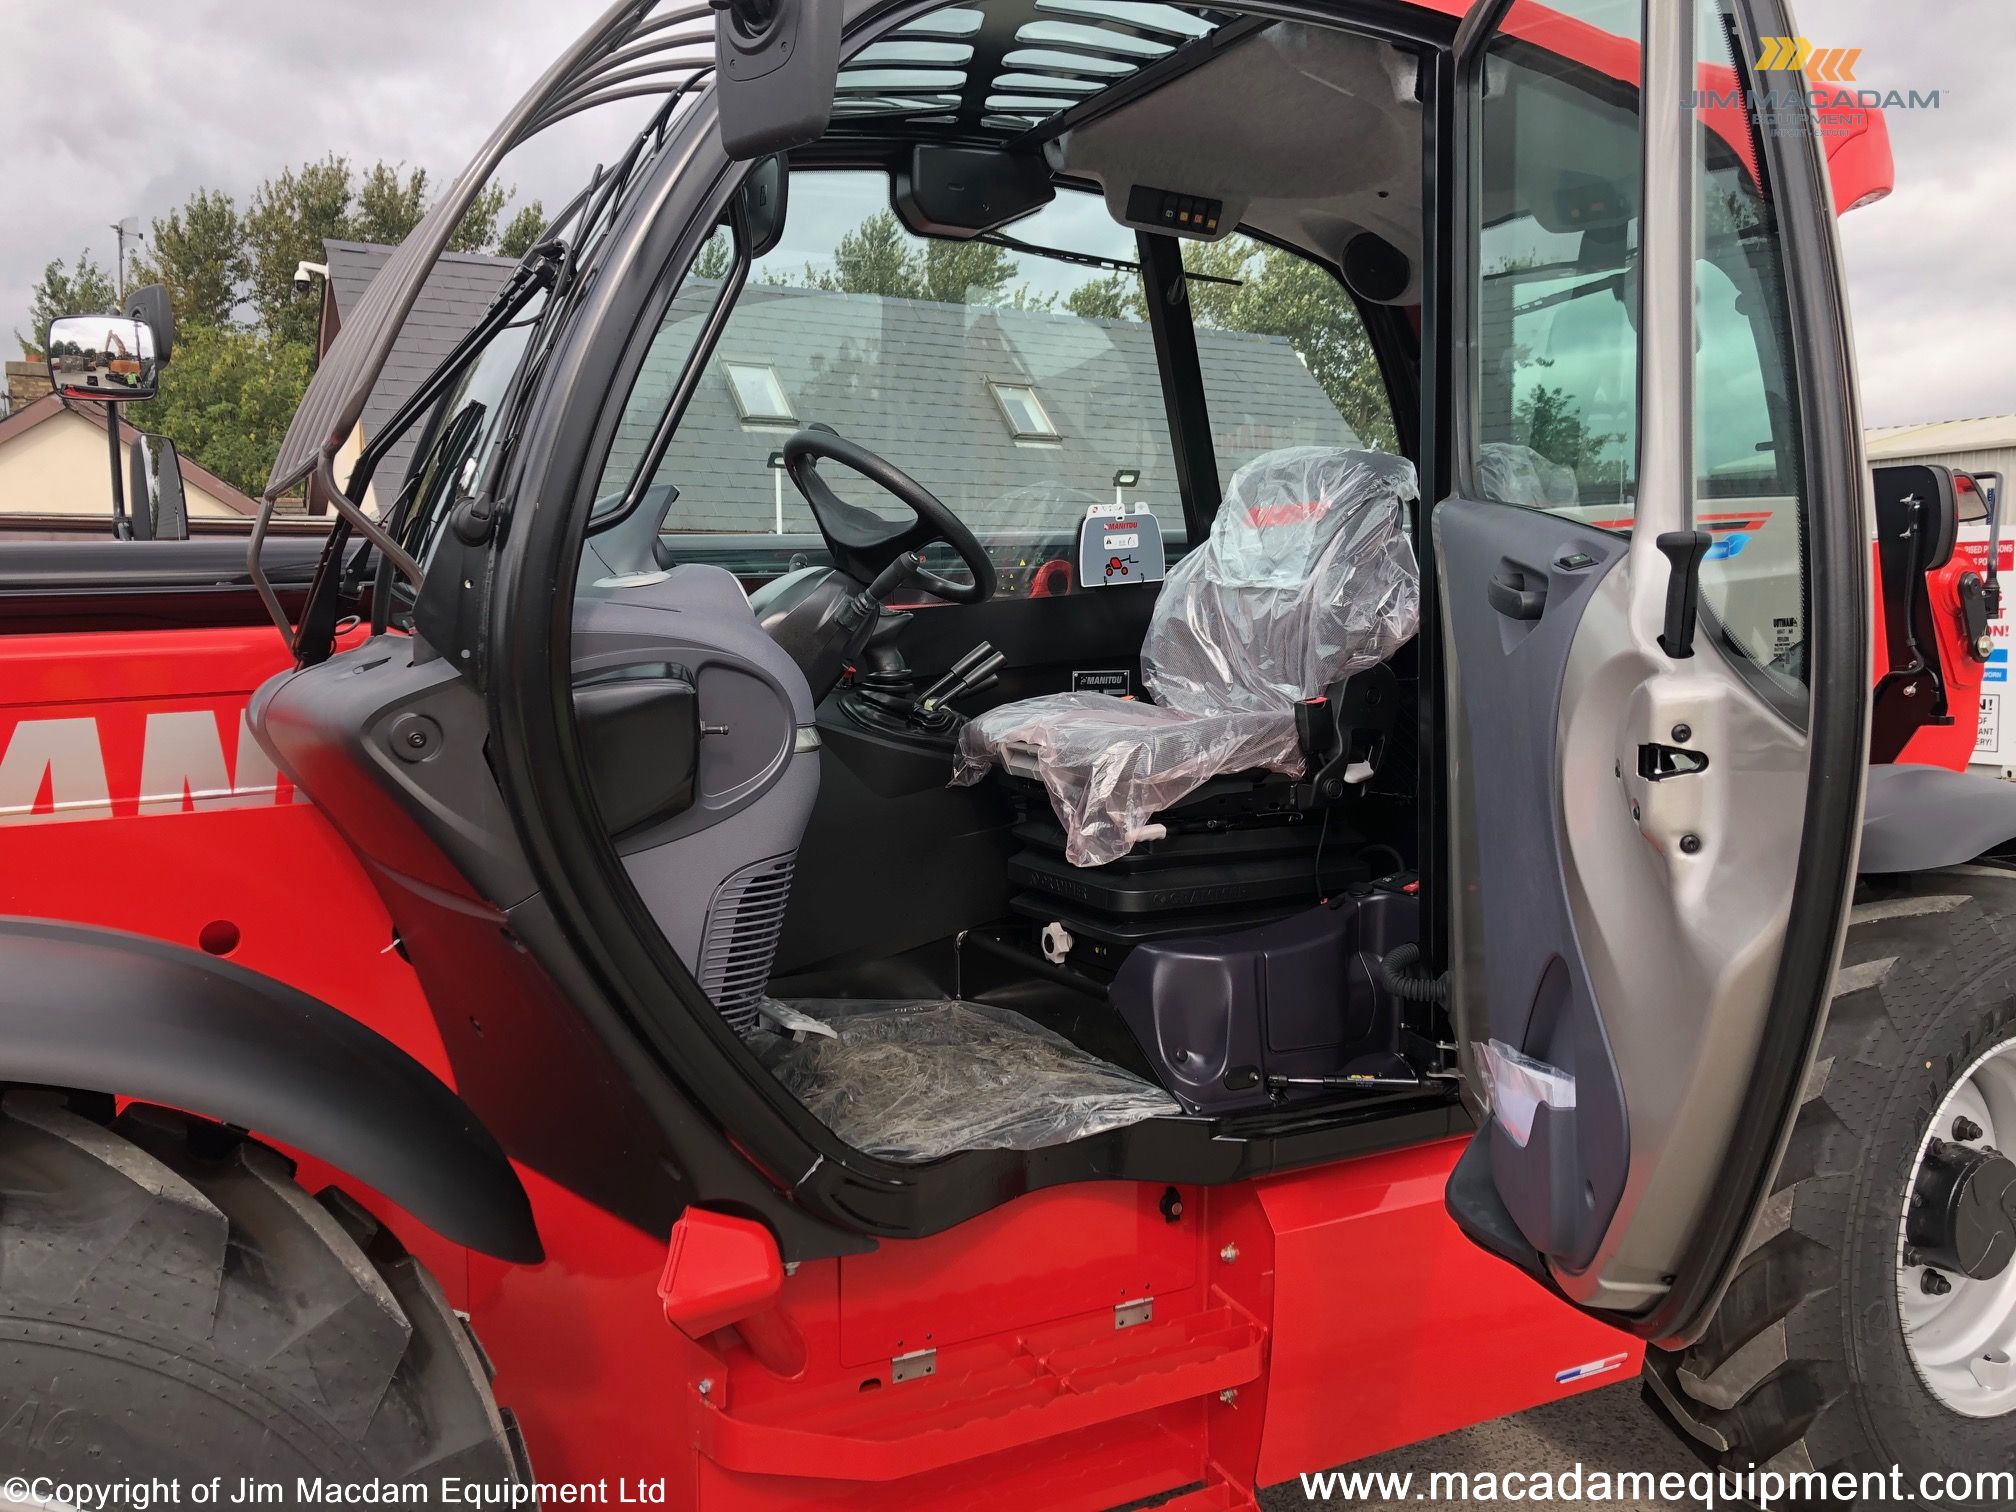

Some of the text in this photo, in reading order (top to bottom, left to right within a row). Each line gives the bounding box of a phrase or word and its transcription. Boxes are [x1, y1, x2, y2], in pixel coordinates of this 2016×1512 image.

[1108, 521, 1138, 530] MANITOU
[1086, 676, 1123, 685] MANITOU
[0, 710, 300, 828] AN
